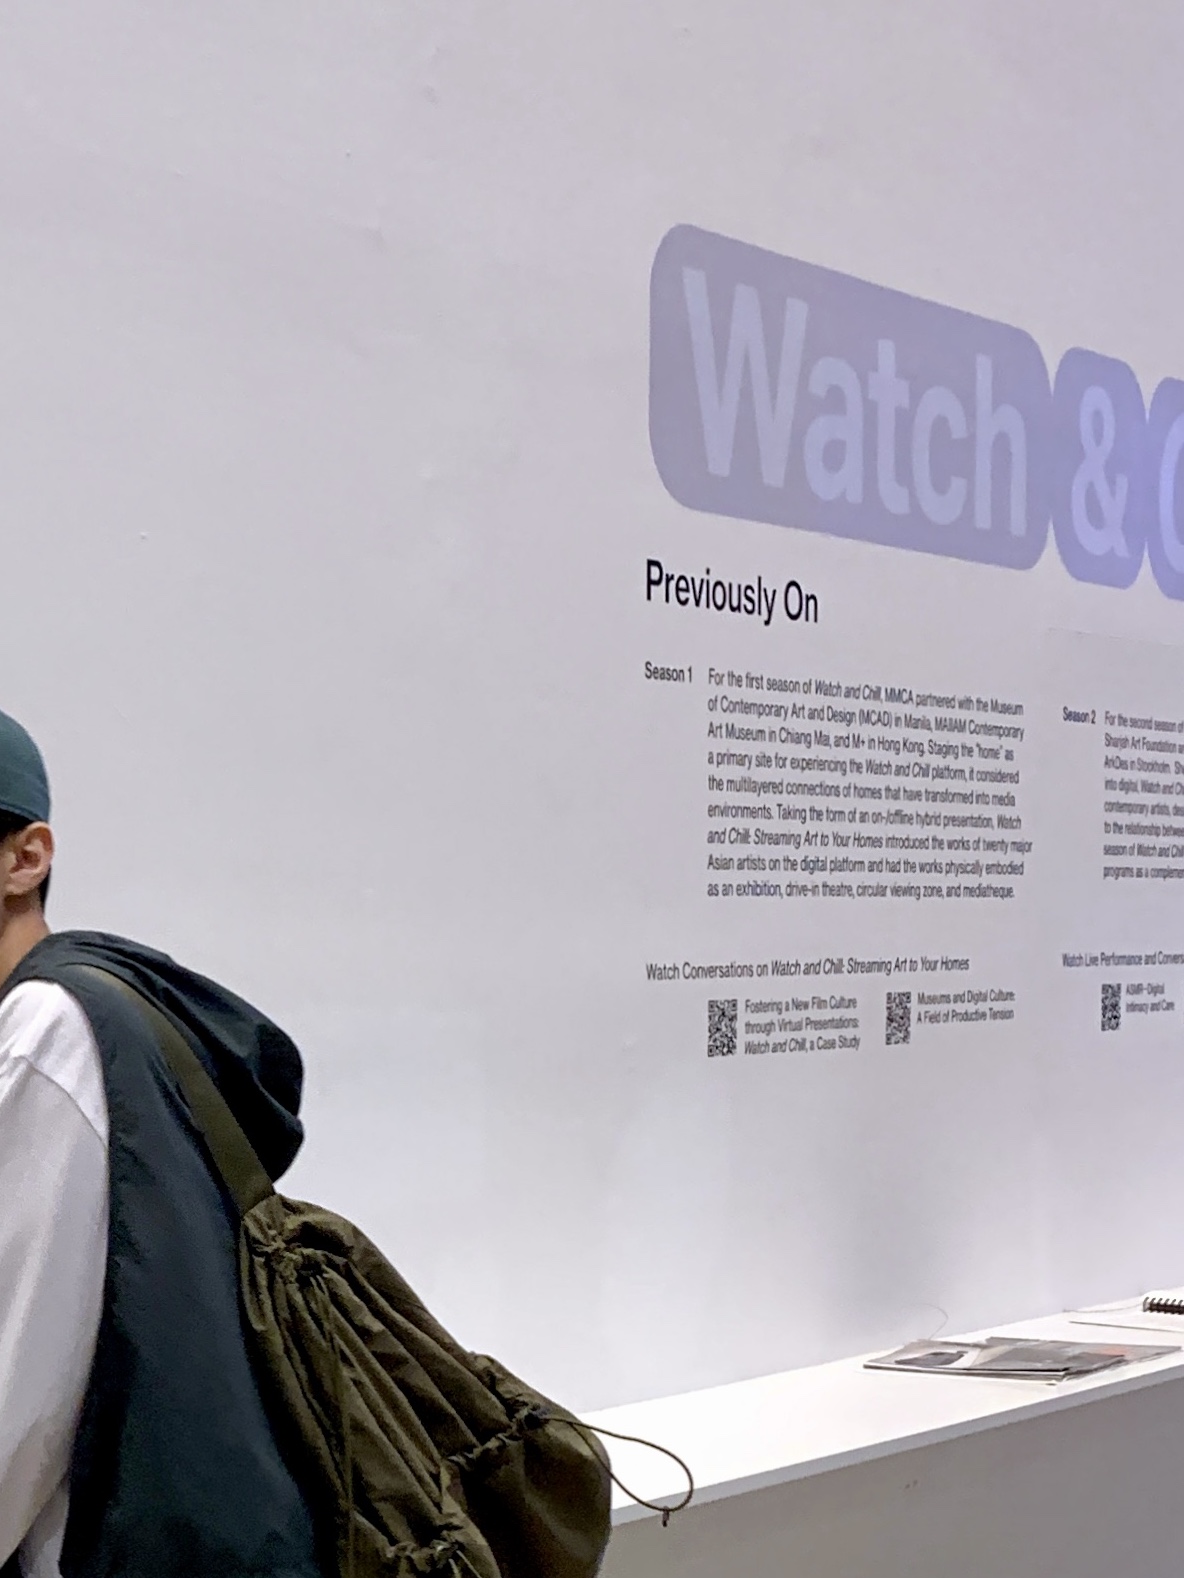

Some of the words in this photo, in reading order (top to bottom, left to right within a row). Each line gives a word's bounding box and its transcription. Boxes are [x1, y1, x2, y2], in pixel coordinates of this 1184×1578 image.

[683, 267, 1027, 537] Watch
[1072, 385, 1128, 557] &
[645, 559, 776, 626] Previously
[784, 581, 818, 623] On
[645, 661, 685, 682] Season
[688, 666, 692, 683] 1
[709, 668, 725, 685] For
[728, 671, 742, 687] the
[746, 672, 763, 690] first
[767, 678, 800, 693] season
[803, 679, 812, 694] of
[815, 679, 841, 697] Watch
[844, 685, 861, 699] and
[885, 688, 913, 704] MMCA
[916, 694, 955, 709] partnered
[958, 696, 974, 710] with
[977, 698, 988, 712] the
[991, 699, 1023, 715] Museum
[708, 696, 717, 711] of
[721, 695, 788, 721] Contemporary
[791, 703, 805, 719] Art
[808, 706, 824, 721] and
[827, 706, 856, 726] Design
[859, 709, 892, 728] (MCAD)
[895, 714, 901, 726] in
[905, 714, 932, 732] Manila,
[969, 720, 1024, 741] Contemporary
[1063, 706, 1090, 723] Season
[1091, 710, 1096, 724] 2
[1105, 710, 1116, 726] For
[708, 721, 722, 738] Art
[725, 723, 765, 741] Museum
[769, 726, 776, 741] in
[779, 727, 811, 749] Chiang
[834, 733, 849, 748] and
[852, 733, 865, 748] M+
[868, 735, 875, 750] in
[878, 736, 900, 755] Hong
[903, 738, 925, 757] Kong.
[928, 739, 958, 759] Staging
[961, 741, 973, 757] the
[1005, 750, 1013, 761] as
[708, 752, 714, 764] a
[717, 749, 752, 770] primary
[756, 752, 772, 768] site
[775, 752, 788, 768] for
[790, 755, 847, 776] experiencing
[849, 759, 863, 774] the
[866, 759, 892, 776] Watch
[894, 762, 910, 777] and
[912, 762, 929, 778] Chill
[932, 764, 967, 782] platform,
[969, 767, 974, 781] it
[976, 769, 1019, 783] considered
[708, 775, 723, 791] the
[727, 776, 783, 797] multilayered
[786, 781, 840, 797] connections
[843, 783, 851, 798] of
[854, 784, 882, 800] homes
[885, 786, 900, 800] that
[903, 786, 922, 801] have
[925, 789, 973, 804] transformed
[976, 790, 989, 805] into
[992, 792, 1015, 806] media
[708, 802, 773, 819] environments.
[777, 804, 806, 824] Taking
[810, 806, 823, 821] the
[826, 807, 845, 822] form
[848, 808, 856, 823] of
[859, 811, 869, 823] an
[916, 811, 941, 828] hybrid
[997, 814, 1021, 829] Watch
[708, 828, 726, 843] and
[754, 828, 801, 849] Streaming
[803, 830, 818, 846] Art
[820, 831, 829, 846] to
[832, 831, 851, 847] Your
[853, 832, 883, 849] Homes
[886, 835, 929, 850] introduced
[932, 836, 944, 850] the
[947, 836, 970, 851] works
[973, 837, 980, 851] of
[983, 839, 1008, 855] twenty
[1010, 839, 1032, 854] major
[707, 854, 734, 869] Asian
[737, 855, 766, 870] artists
[769, 857, 780, 871] on
[783, 856, 798, 871] the
[801, 856, 827, 875] digital
[830, 856, 865, 875] platform
[868, 858, 883, 873] and
[886, 858, 901, 873] had
[903, 859, 916, 873] the
[919, 859, 942, 873] works
[945, 859, 983, 877] physically
[986, 861, 1024, 875] embodied
[708, 884, 719, 896] as
[722, 883, 733, 896] an
[736, 881, 783, 898] exhibition,
[786, 882, 820, 897] drive-in
[822, 882, 855, 899] theatre,
[857, 882, 887, 897] circular
[890, 882, 920, 900] viewing
[923, 885, 944, 898] zone,
[946, 884, 961, 897] and
[646, 963, 679, 981] Watch
[682, 962, 753, 979] Conversations
[757, 964, 768, 977] on
[771, 959, 801, 976] Watch
[803, 960, 821, 975] and
[847, 957, 891, 976] Streaming
[894, 957, 907, 973] Art
[910, 959, 917, 972] to
[921, 957, 939, 972] Your
[941, 956, 969, 971] Homes
[745, 999, 782, 1014] Fostering
[785, 1001, 789, 1012] a
[792, 998, 809, 1011] New
[812, 997, 827, 1010] Film
[829, 995, 857, 1009] Culture
[918, 993, 951, 1005] Museums
[953, 991, 965, 1004] and
[967, 989, 988, 1005] Digital
[745, 1021, 775, 1036] through
[778, 1018, 802, 1032] Virtual
[918, 1011, 921, 1023] A
[943, 1009, 950, 1021] of
[745, 1041, 770, 1054] Watch
[772, 1040, 787, 1053] and
[810, 1041, 814, 1050] a
[817, 1036, 836, 1050] Case
[839, 1035, 860, 1050] Study
